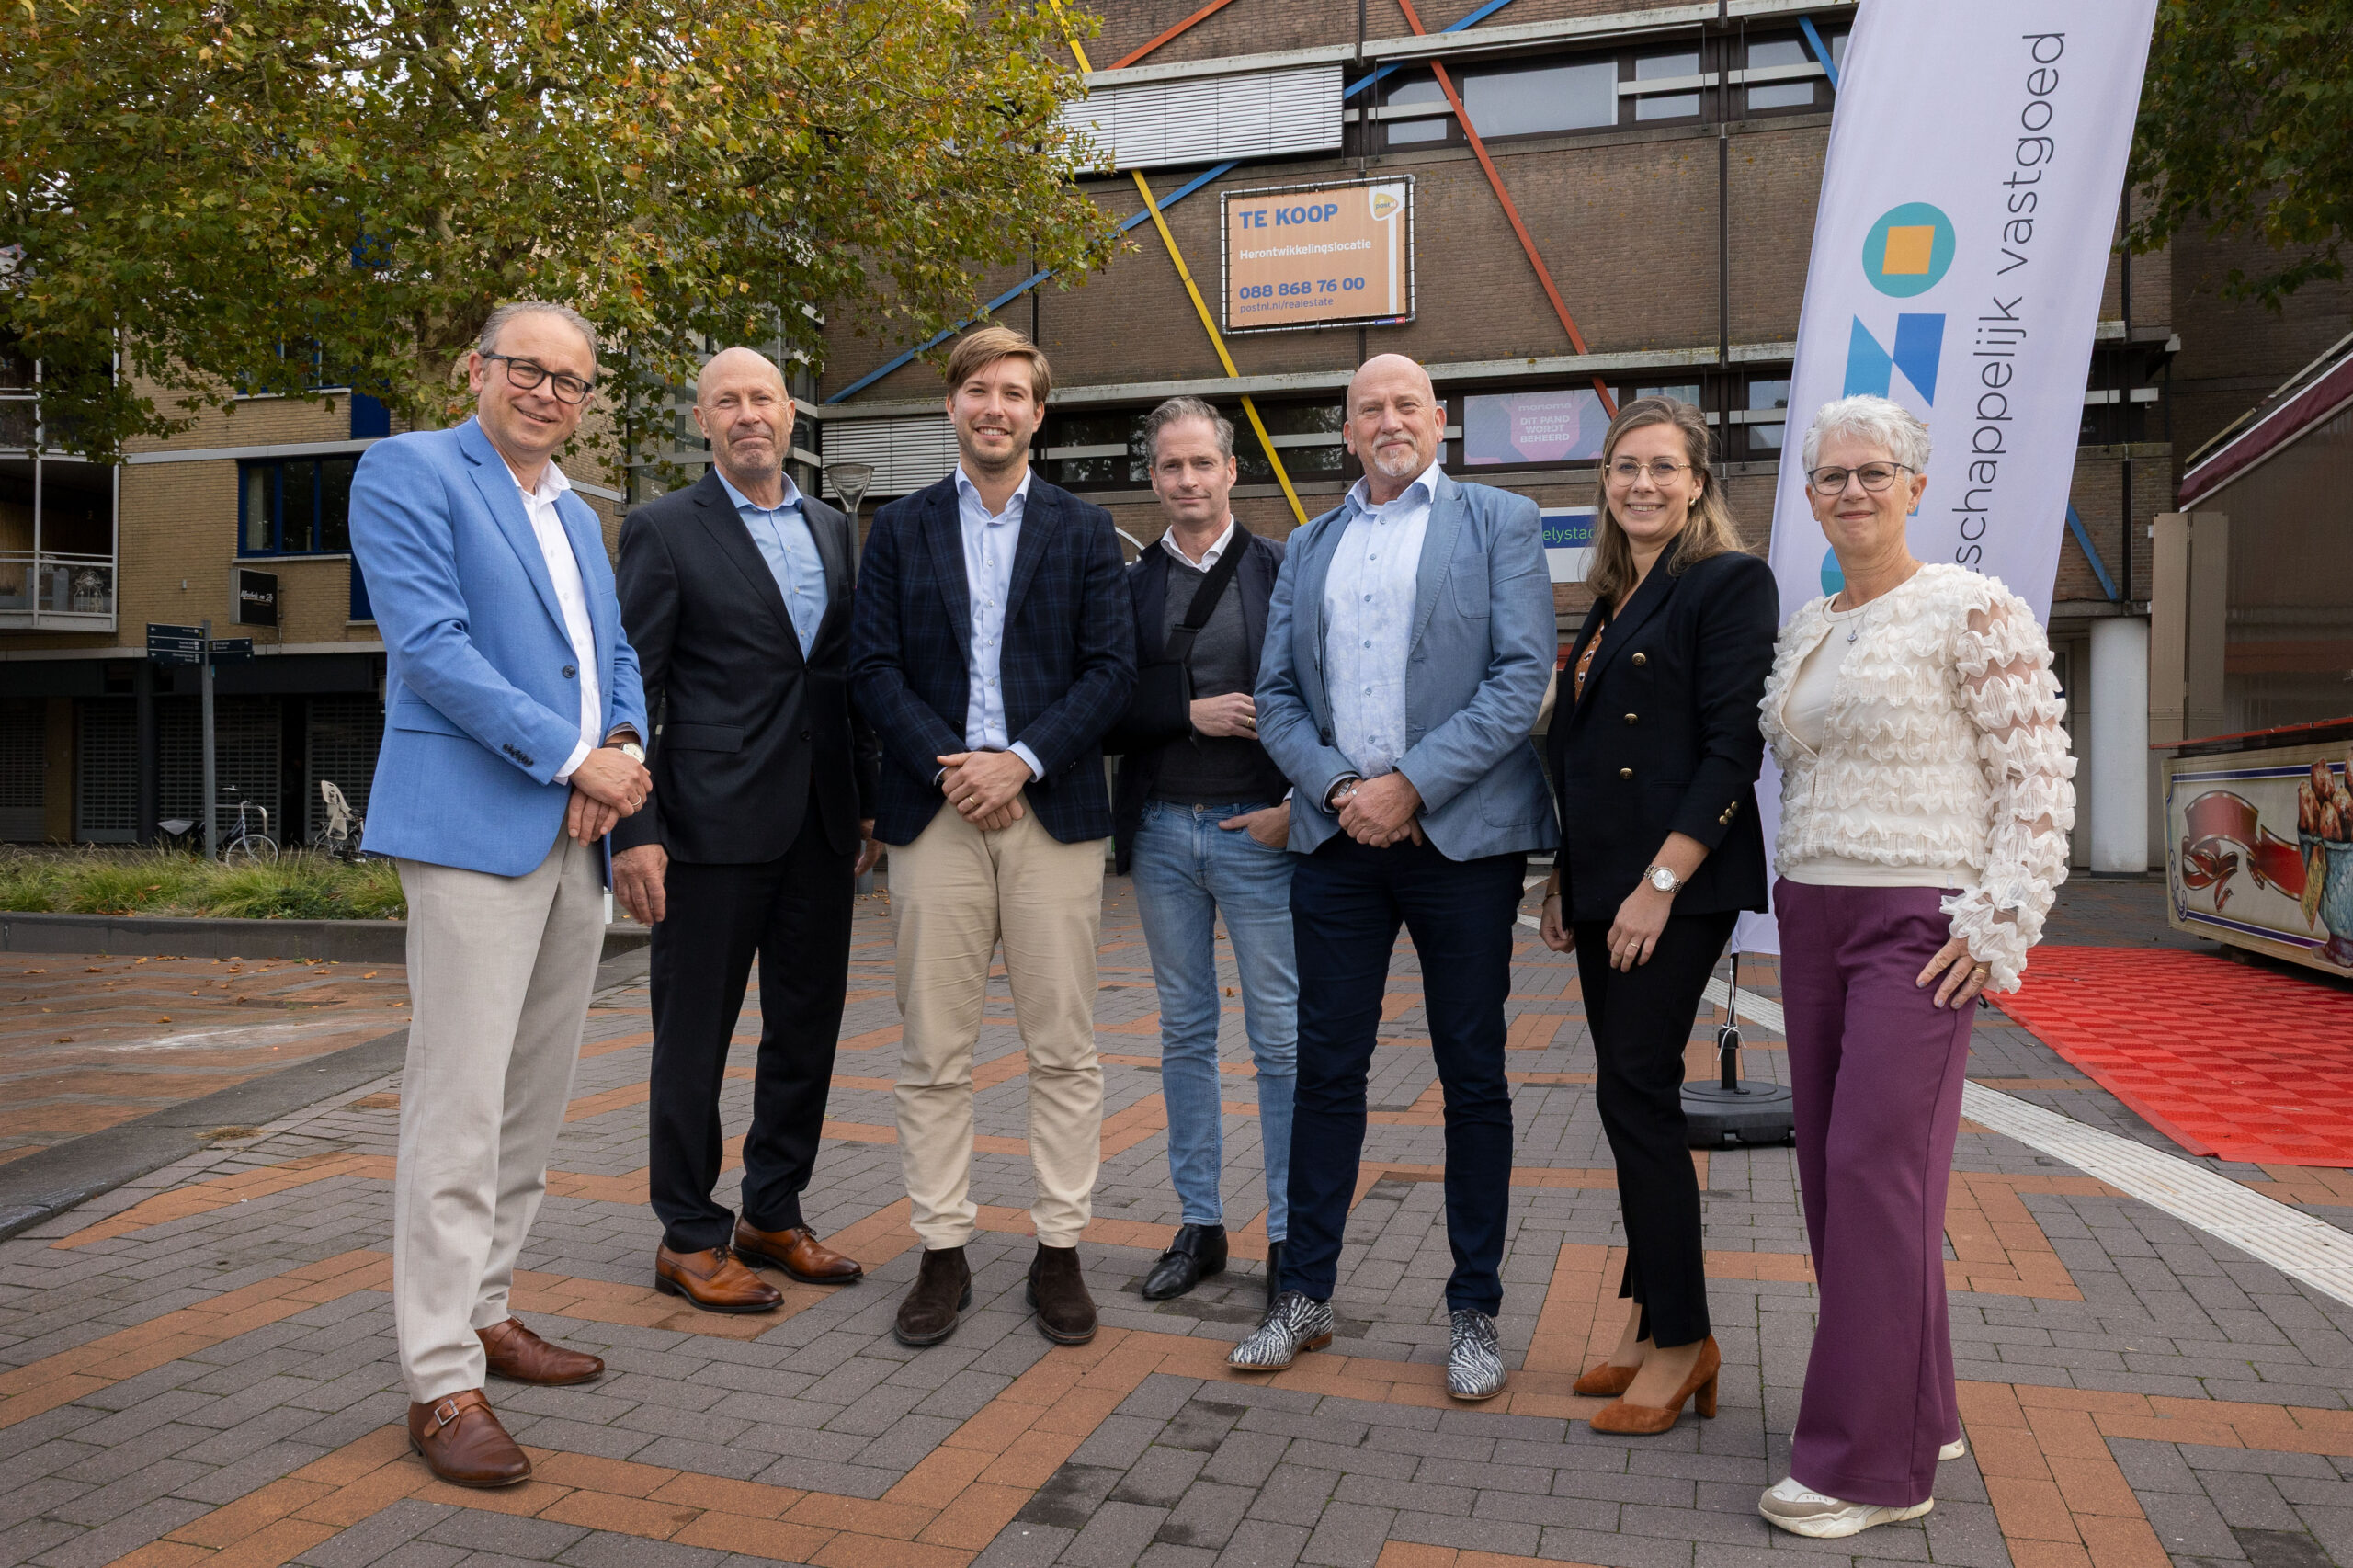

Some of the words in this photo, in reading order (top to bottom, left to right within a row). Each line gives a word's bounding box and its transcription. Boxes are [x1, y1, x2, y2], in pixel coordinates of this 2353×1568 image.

[1375, 199, 1397, 210] postnl
[1239, 210, 1267, 229] TE
[1276, 203, 1338, 226] KOOP
[1240, 239, 1371, 260] Herontwikkelingslocatie
[1239, 284, 1273, 300] 088
[1279, 281, 1312, 297] 868
[1317, 279, 1337, 293] 76
[1342, 277, 1365, 291] 00
[1240, 297, 1334, 314] postnl.nl/realestate
[1951, 296, 2028, 576] schappelijk
[1997, 32, 2065, 276] vastgoed
[1518, 403, 1572, 412] monoma
[1520, 416, 1537, 426] DIT
[1540, 415, 1571, 425] PAND
[1526, 424, 1565, 434] WORDT
[1520, 433, 1570, 443] BEHEERD
